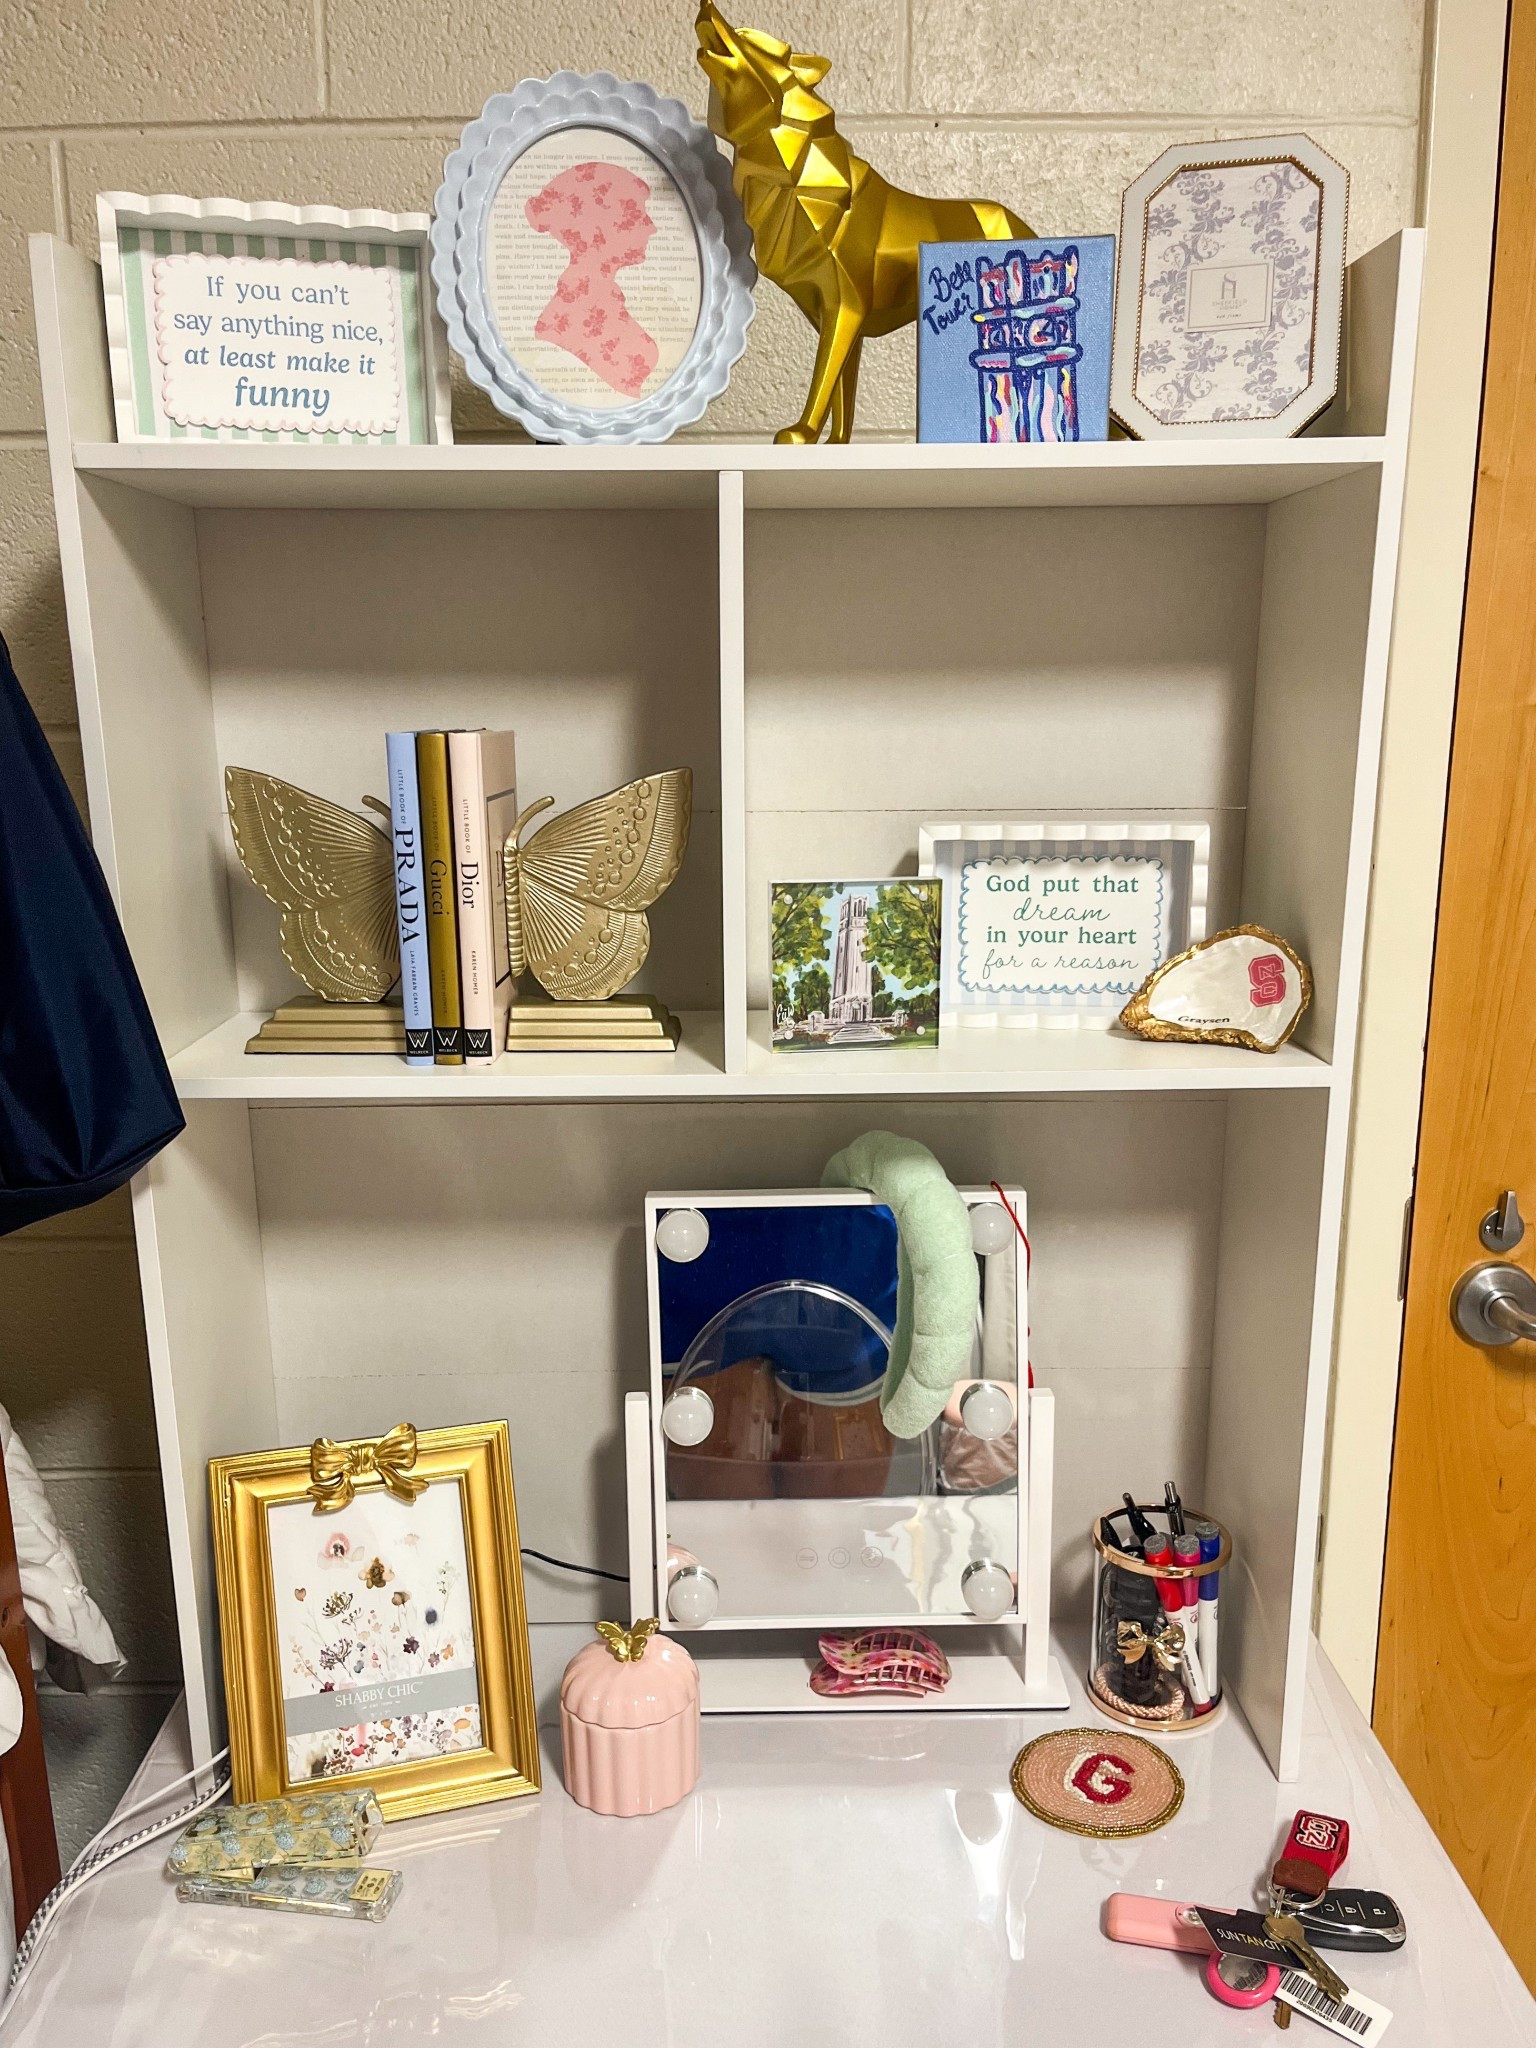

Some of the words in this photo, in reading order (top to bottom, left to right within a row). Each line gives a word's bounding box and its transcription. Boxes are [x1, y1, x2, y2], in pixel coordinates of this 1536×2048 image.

[206, 275, 225, 298] If
[235, 282, 281, 304] you
[291, 284, 350, 305] can't
[922, 292, 975, 335] Tower
[173, 313, 213, 335] say
[221, 314, 324, 344] anything
[331, 320, 384, 345] nice,
[184, 346, 209, 365] at
[219, 346, 276, 369] least
[286, 352, 350, 374] make
[359, 354, 376, 376] it
[235, 376, 330, 417] funny
[400, 815, 406, 825] OF
[465, 846, 471, 854] OF
[395, 827, 420, 945] PRADA
[430, 859, 450, 916] Gucci
[461, 861, 479, 909] Dior
[986, 875, 1030, 893] God
[1042, 877, 1080, 897] put
[1092, 875, 1139, 893] that
[1013, 897, 1111, 922] dream
[987, 926, 1006, 943] in
[1018, 928, 1069, 948] your
[1078, 926, 1137, 945] heart
[982, 949, 1023, 980] for
[1031, 957, 1047, 968] a
[1054, 954, 1139, 970] reason
[1177, 1015, 1230, 1025] Graysen
[334, 1687, 385, 1708] SHABBY
[387, 1681, 420, 1698] CHIC
[1066, 1752, 1135, 1804] G
[1238, 1933, 1265, 1948] TAN
